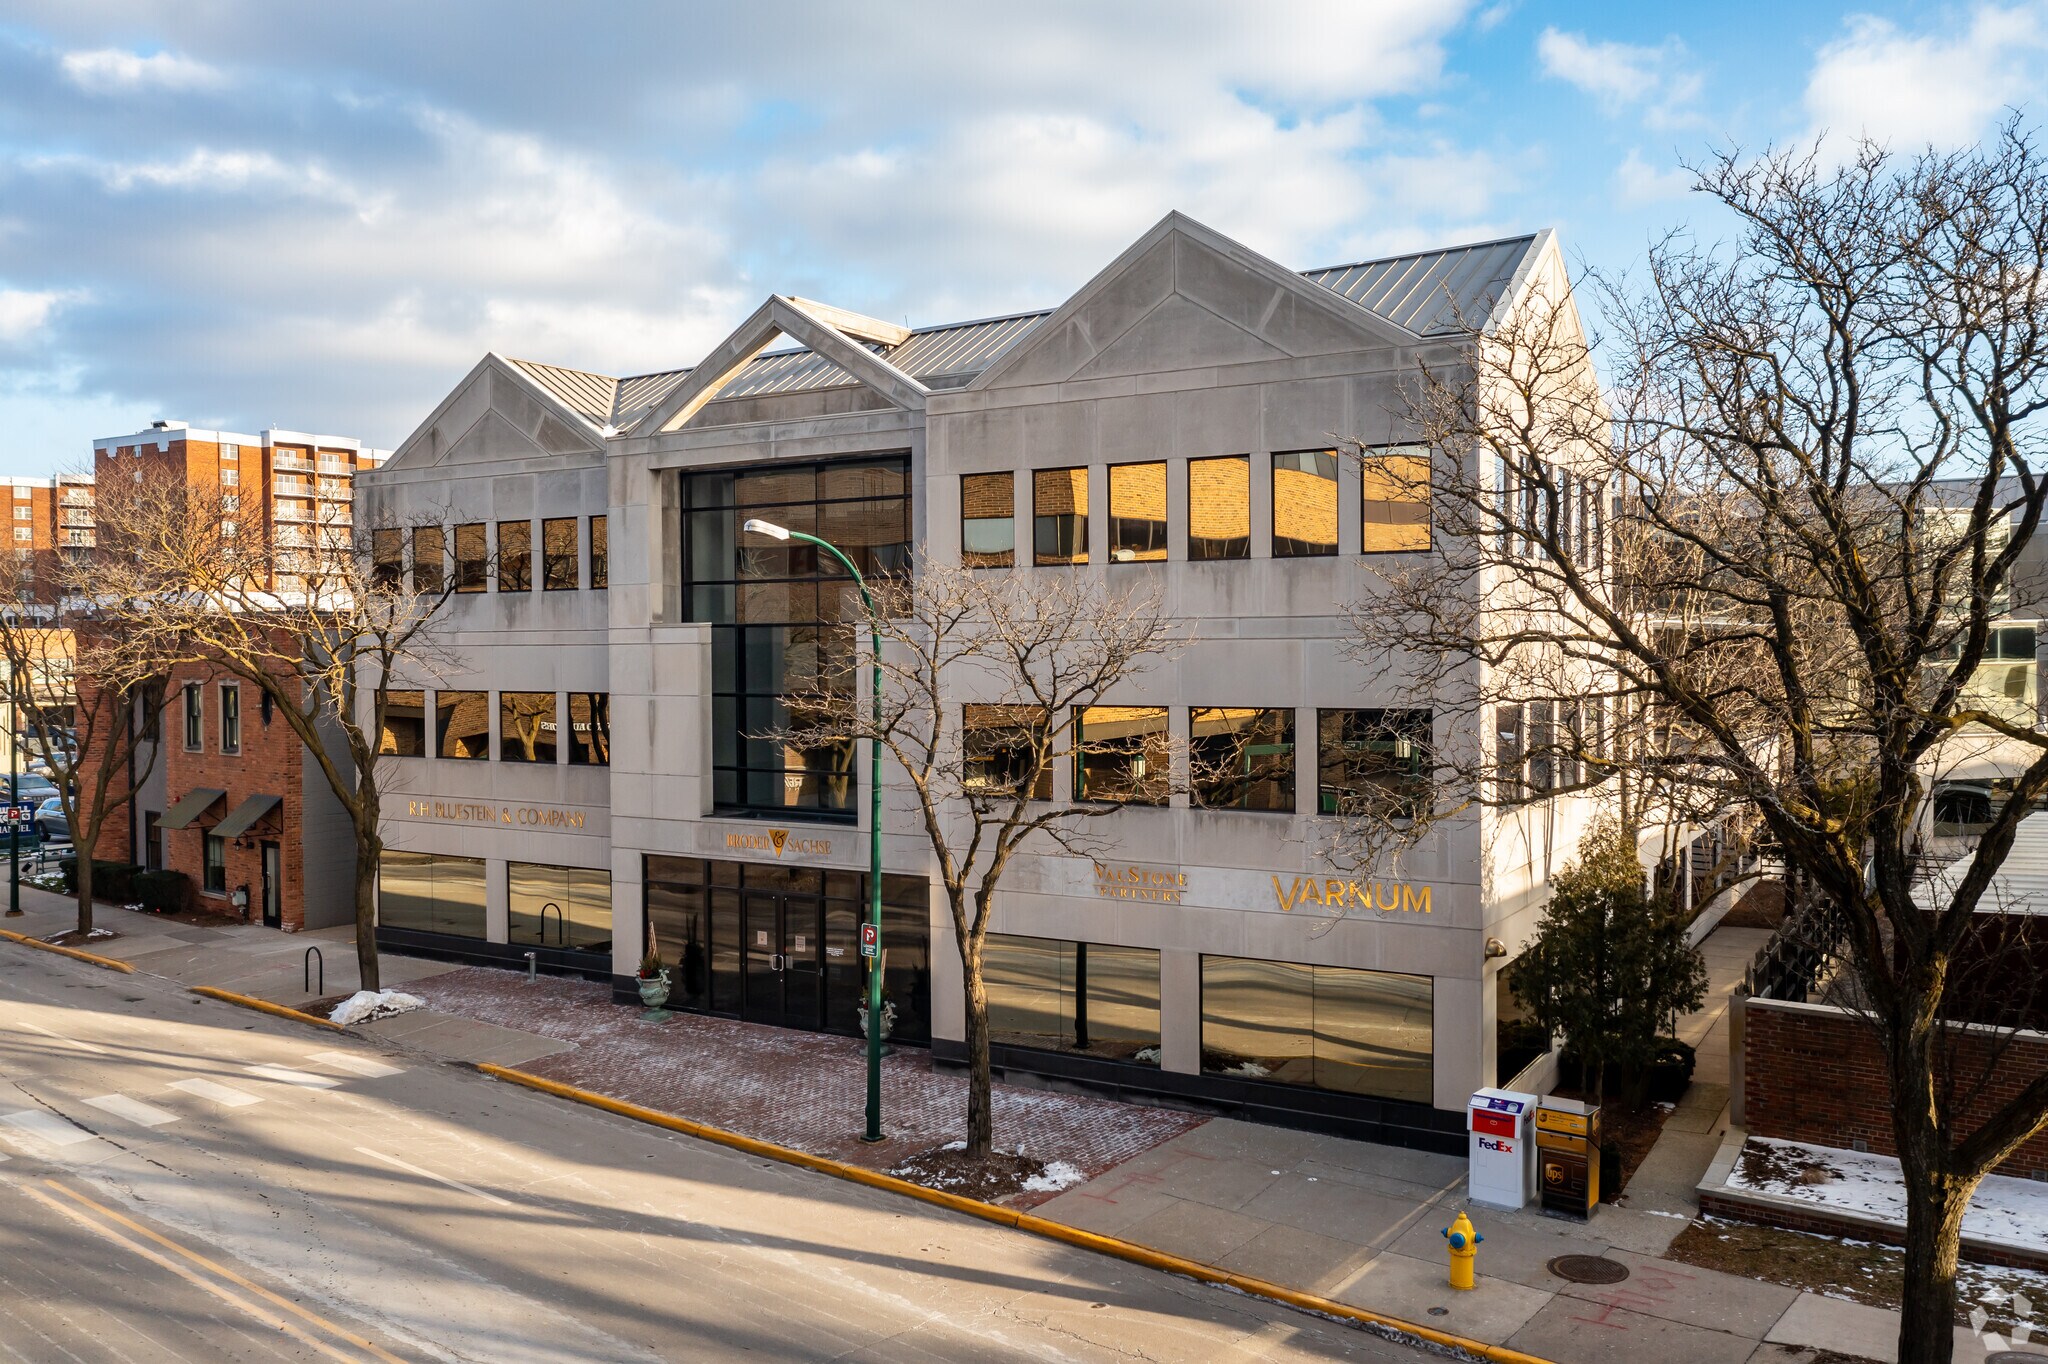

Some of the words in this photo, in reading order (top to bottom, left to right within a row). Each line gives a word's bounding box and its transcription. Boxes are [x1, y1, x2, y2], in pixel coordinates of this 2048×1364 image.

[409, 800, 431, 817] R.H.
[435, 802, 496, 823] BLUESTEIN
[501, 807, 512, 824] &
[517, 807, 587, 829] COMPANY
[726, 832, 770, 849] BRODER
[787, 838, 832, 855] SACHSE
[1100, 886, 1181, 902] PARTNERS
[1271, 874, 1432, 914] VARNUM
[1478, 1137, 1513, 1154] FedEx
[1546, 1168, 1562, 1182] ups
